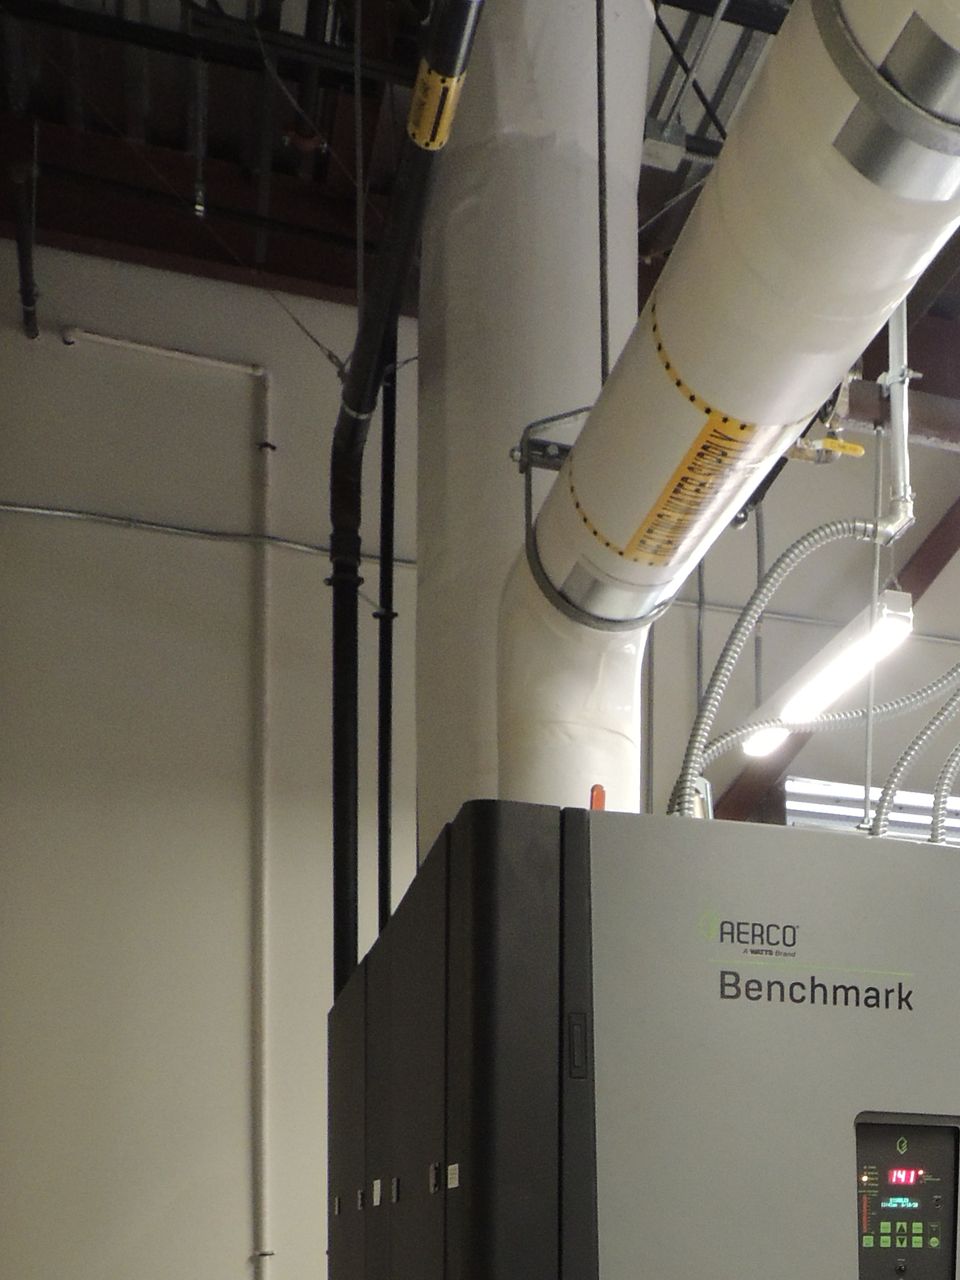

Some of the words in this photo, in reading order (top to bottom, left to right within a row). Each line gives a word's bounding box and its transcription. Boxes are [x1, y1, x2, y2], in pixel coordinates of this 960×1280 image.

[687, 428, 750, 478] SUPPLY
[719, 920, 797, 948] AERCO
[719, 970, 914, 1011] Benchmark
[892, 1169, 915, 1183] 141
